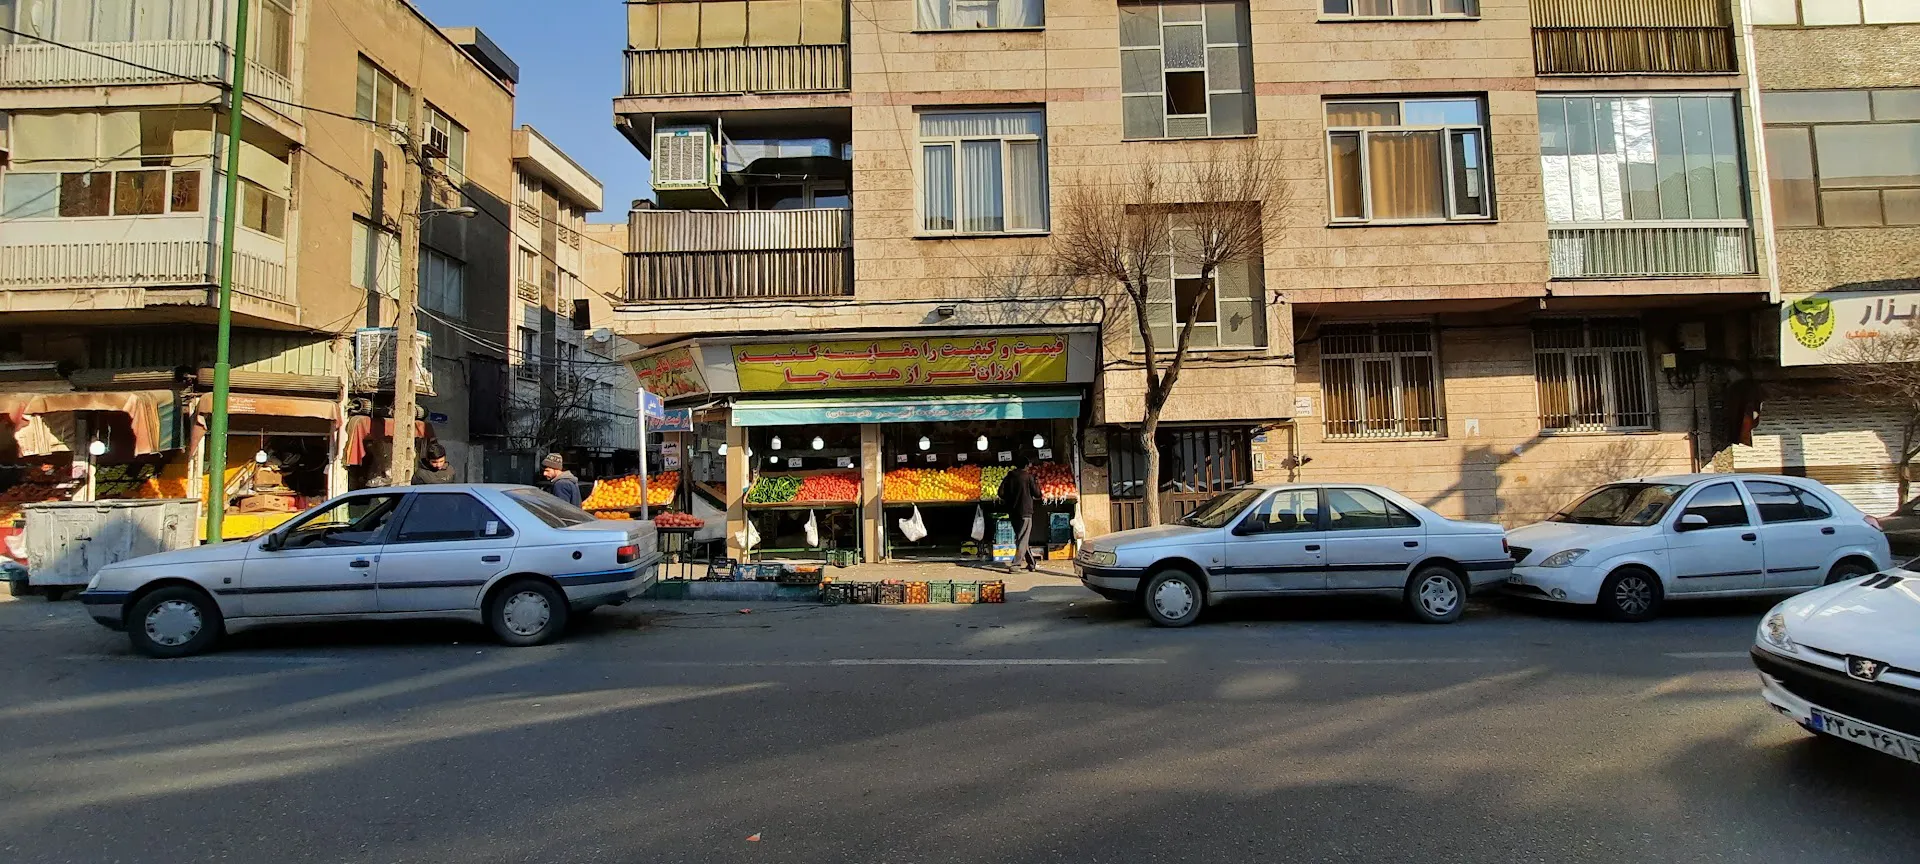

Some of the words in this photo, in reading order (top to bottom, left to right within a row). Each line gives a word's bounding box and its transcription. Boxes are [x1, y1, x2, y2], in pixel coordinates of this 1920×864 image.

[737, 343, 819, 367] کنید
[821, 341, 919, 364] مقایسه
[922, 340, 938, 362] را
[940, 338, 998, 360] کیفیت
[1000, 344, 1011, 360] و
[1013, 336, 1065, 357] قیمت
[784, 366, 831, 386] جا
[833, 366, 902, 382] همه
[905, 363, 920, 384] از
